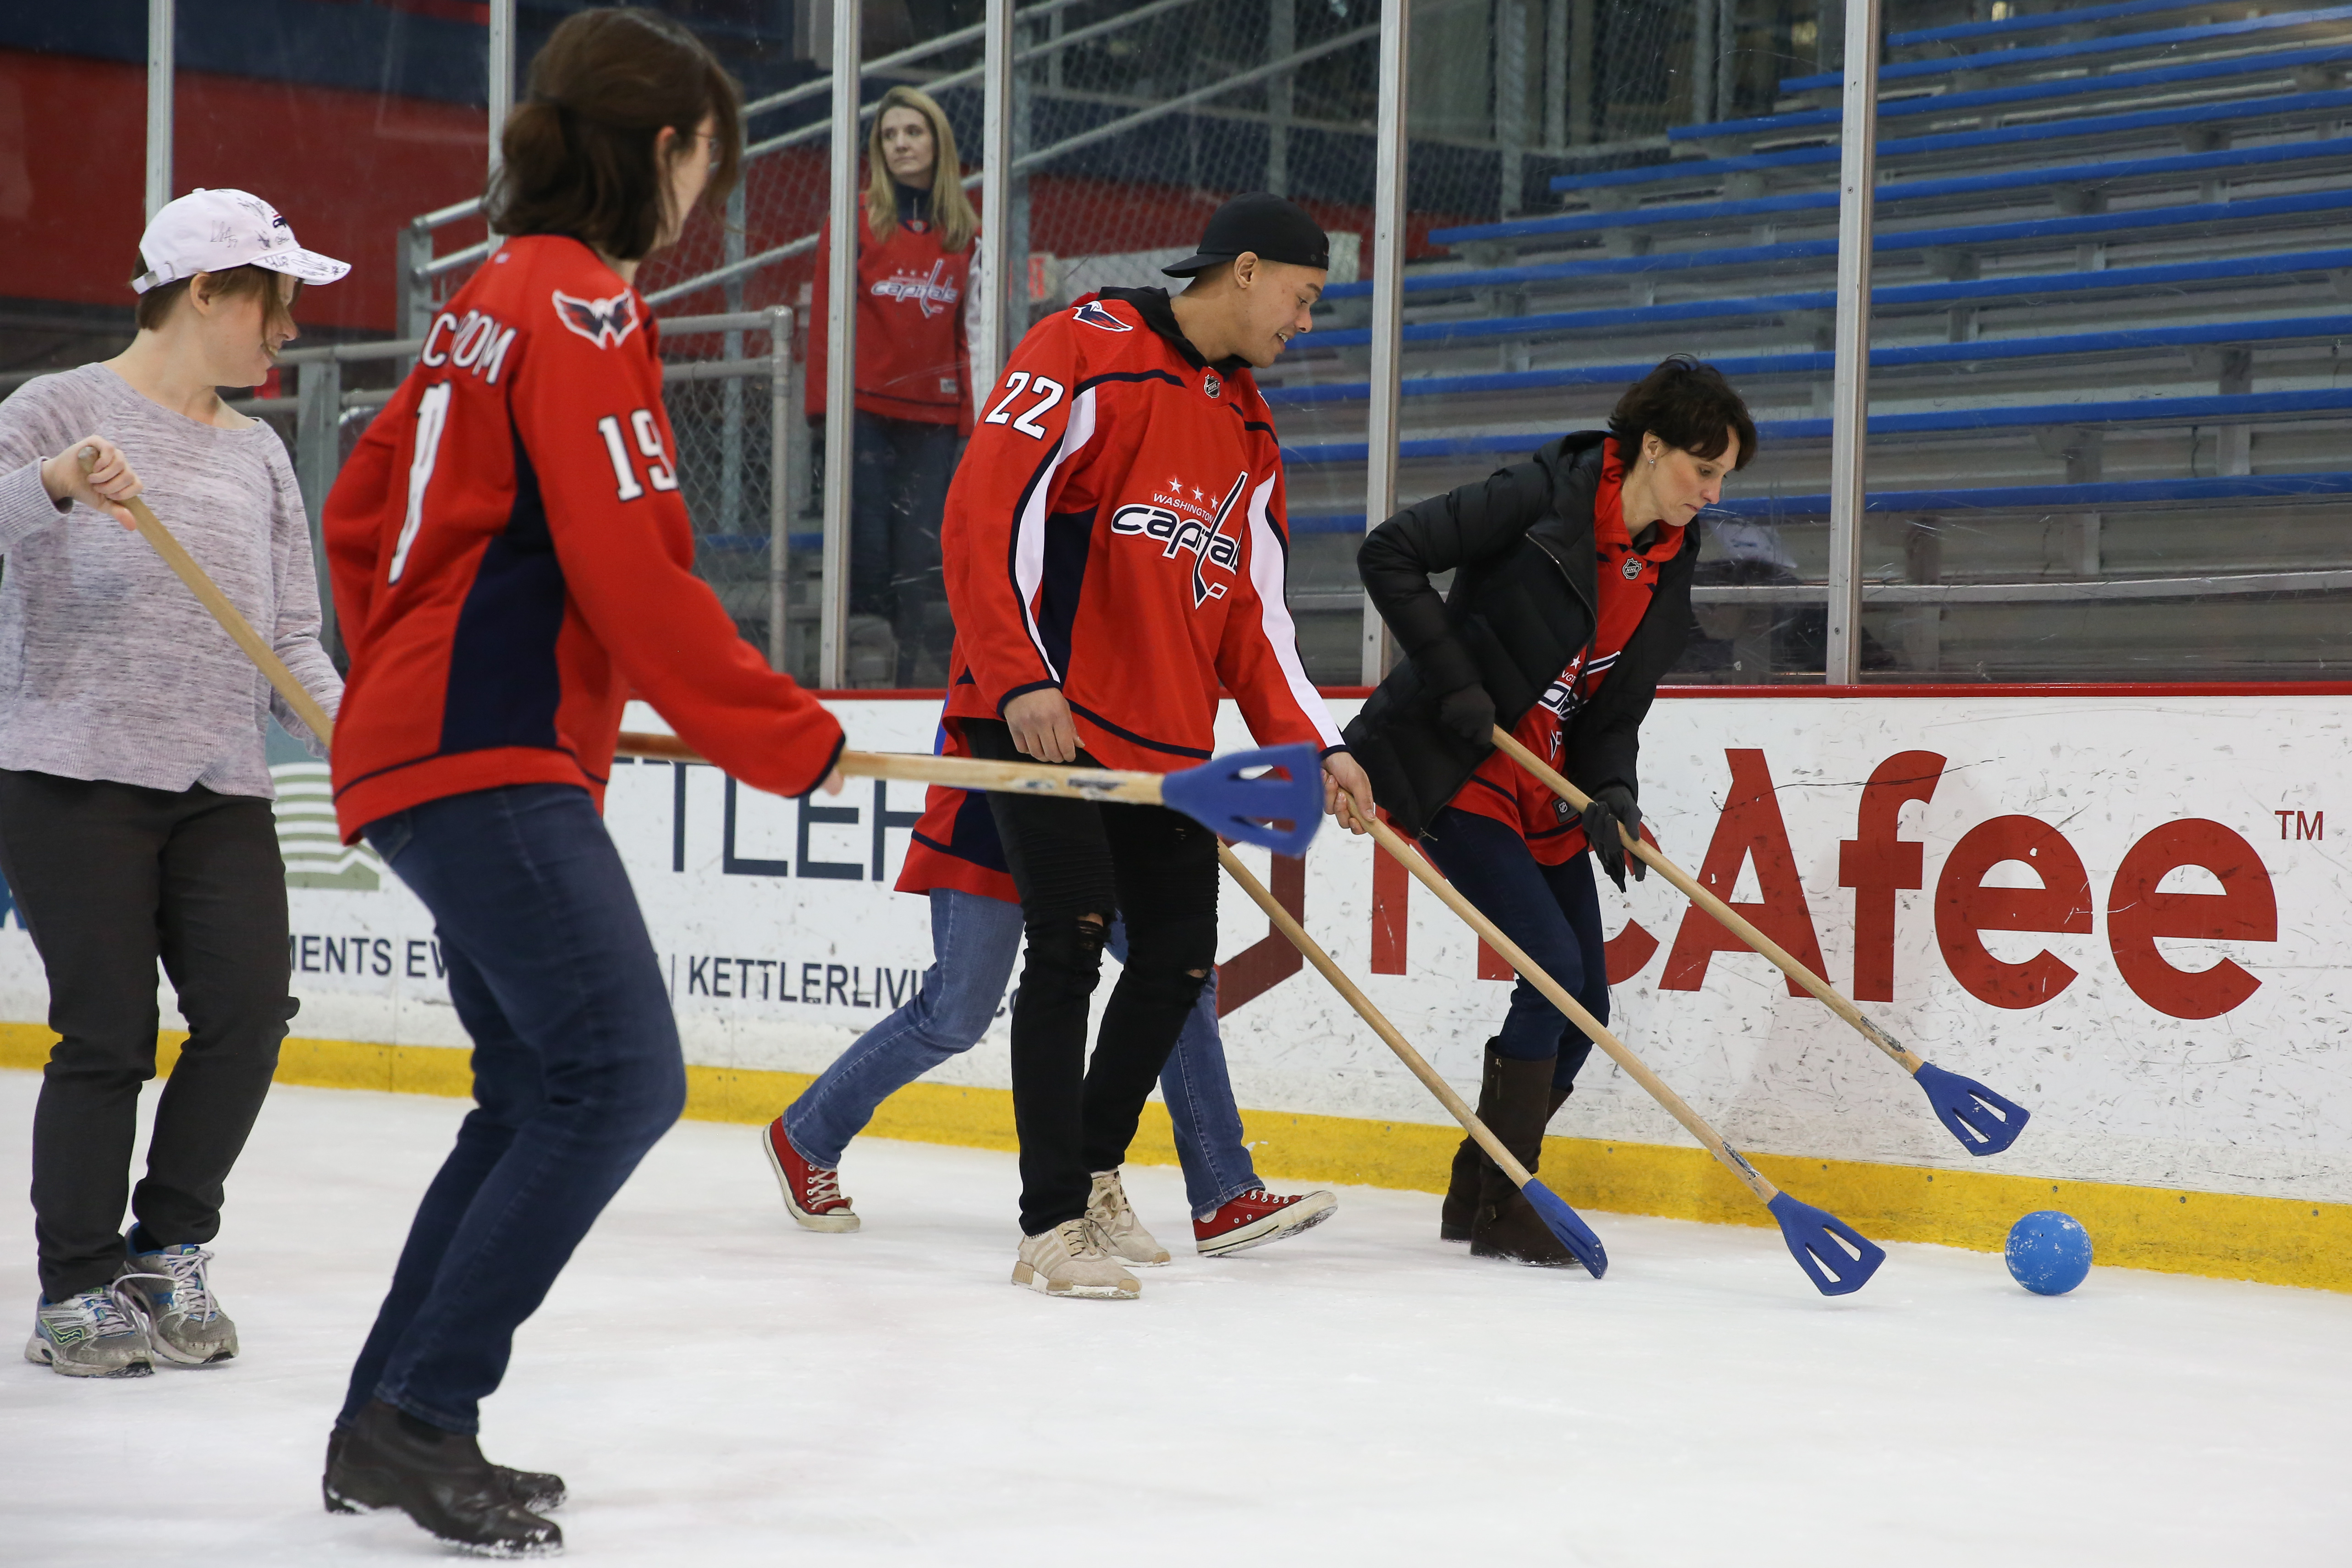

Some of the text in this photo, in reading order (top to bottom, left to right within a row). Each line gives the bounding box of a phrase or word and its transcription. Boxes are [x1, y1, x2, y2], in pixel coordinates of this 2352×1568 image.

[984, 371, 1066, 440] 22
[1208, 383, 1217, 391] NHL
[598, 408, 679, 502] 19
[1153, 492, 1215, 524] WASHINGTON
[1111, 470, 1248, 610] capital
[2275, 810, 2323, 840] TM
